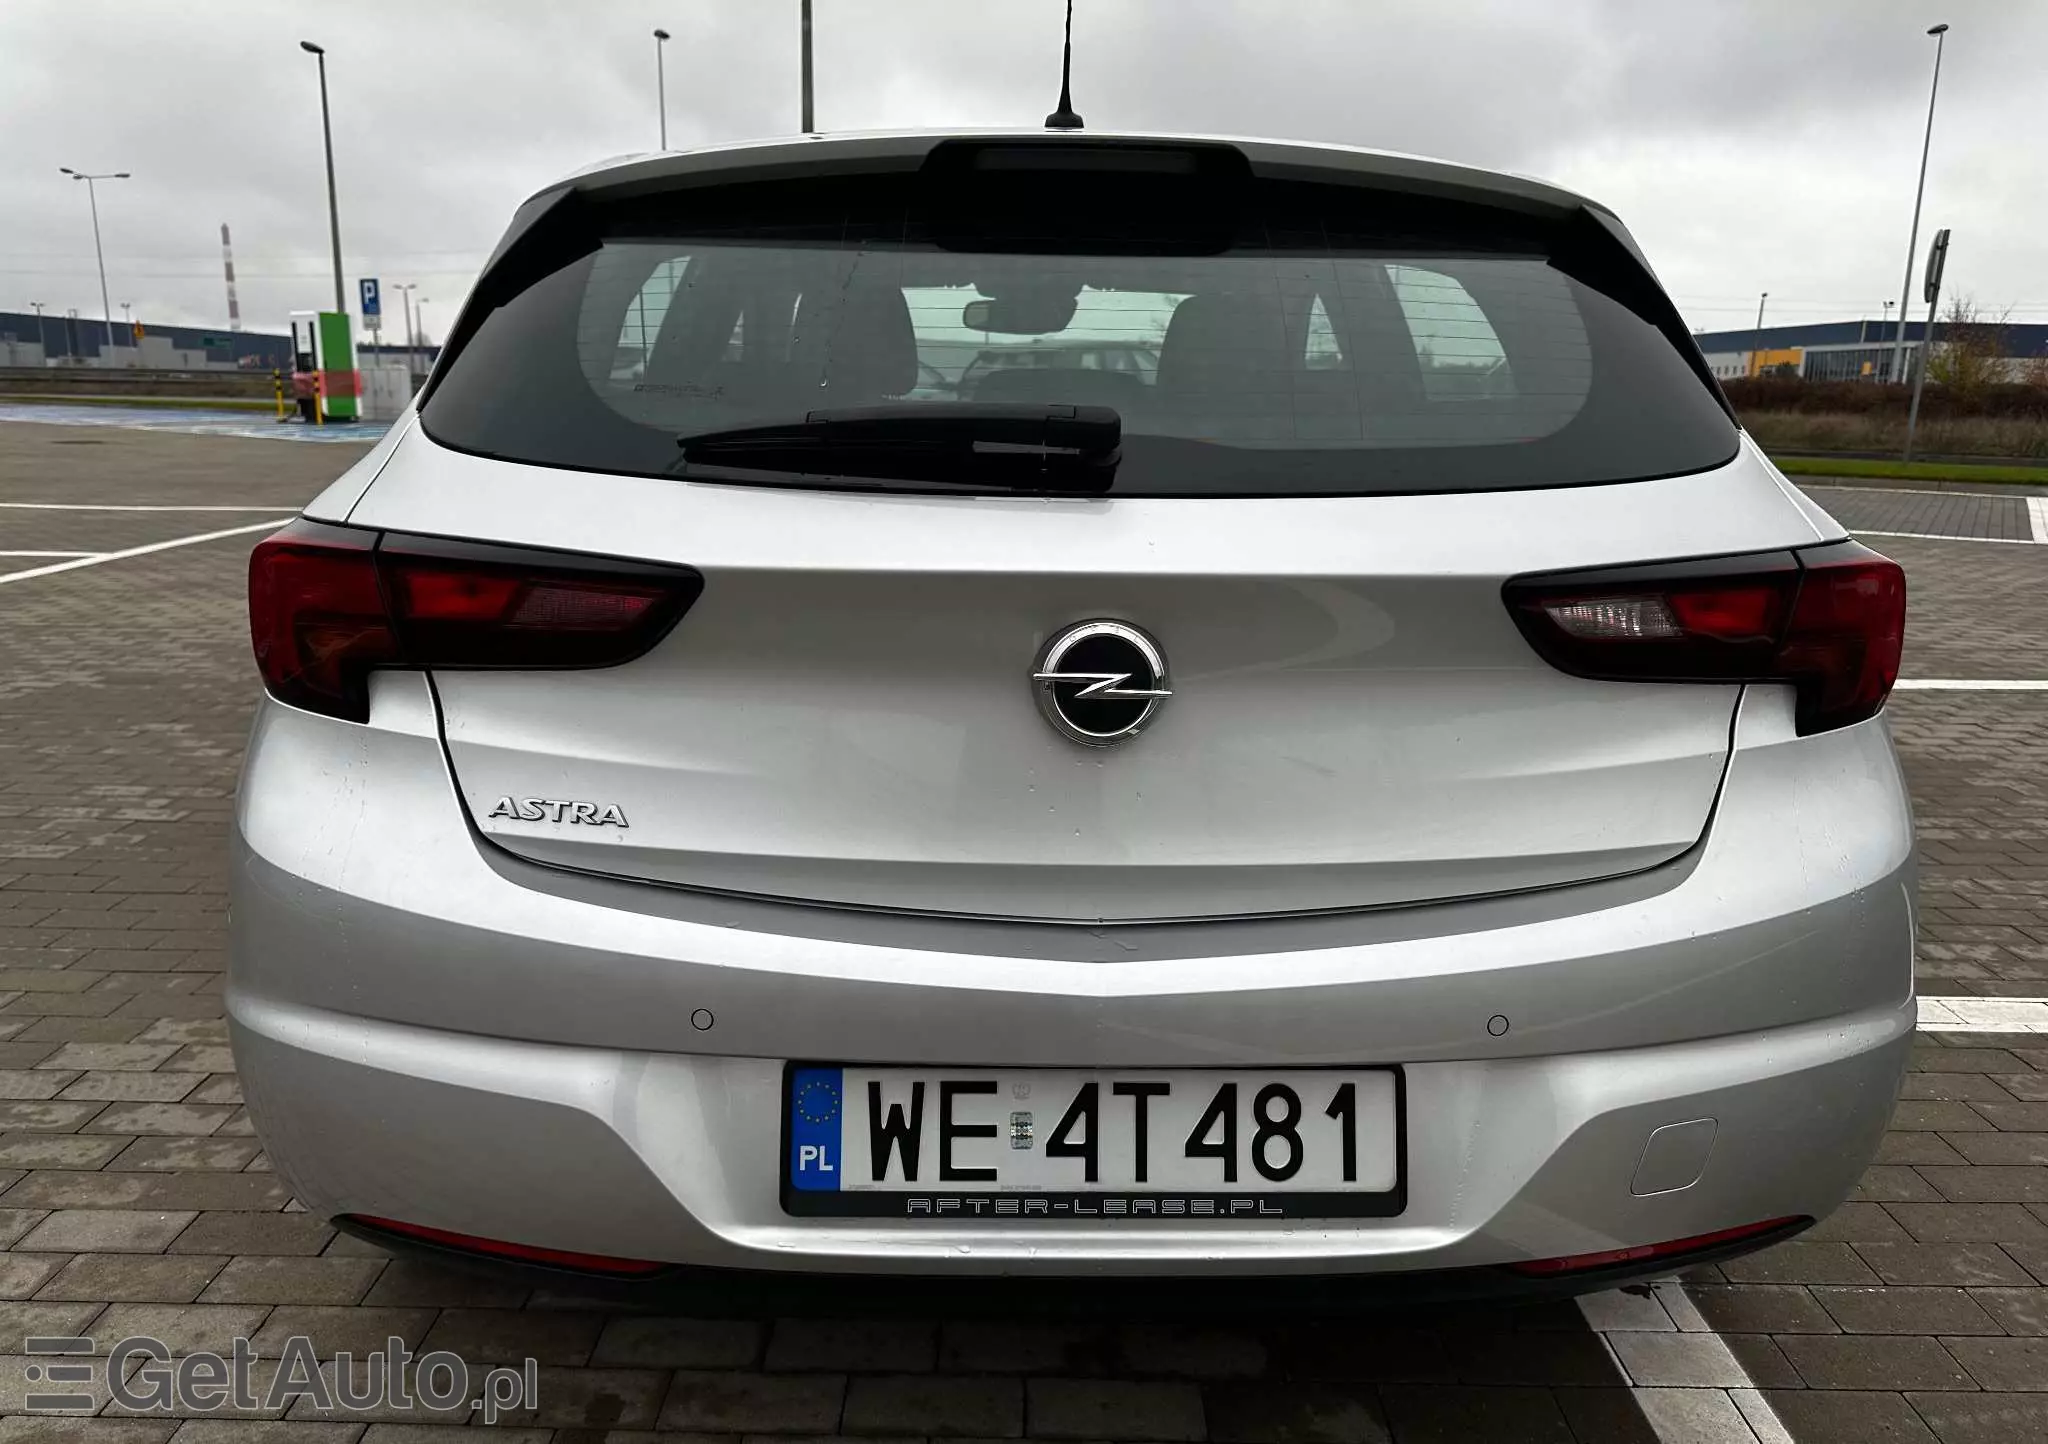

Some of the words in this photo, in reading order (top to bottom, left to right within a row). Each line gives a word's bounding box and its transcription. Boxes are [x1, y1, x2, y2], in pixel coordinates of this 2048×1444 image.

[363, 281, 376, 303] P
[488, 796, 629, 828] ASTRA
[868, 1081, 998, 1182] WE
[1045, 1081, 1357, 1183] 4T481
[799, 1145, 834, 1171] PL
[906, 1198, 1284, 1214] AFTER-LEASE.PL
